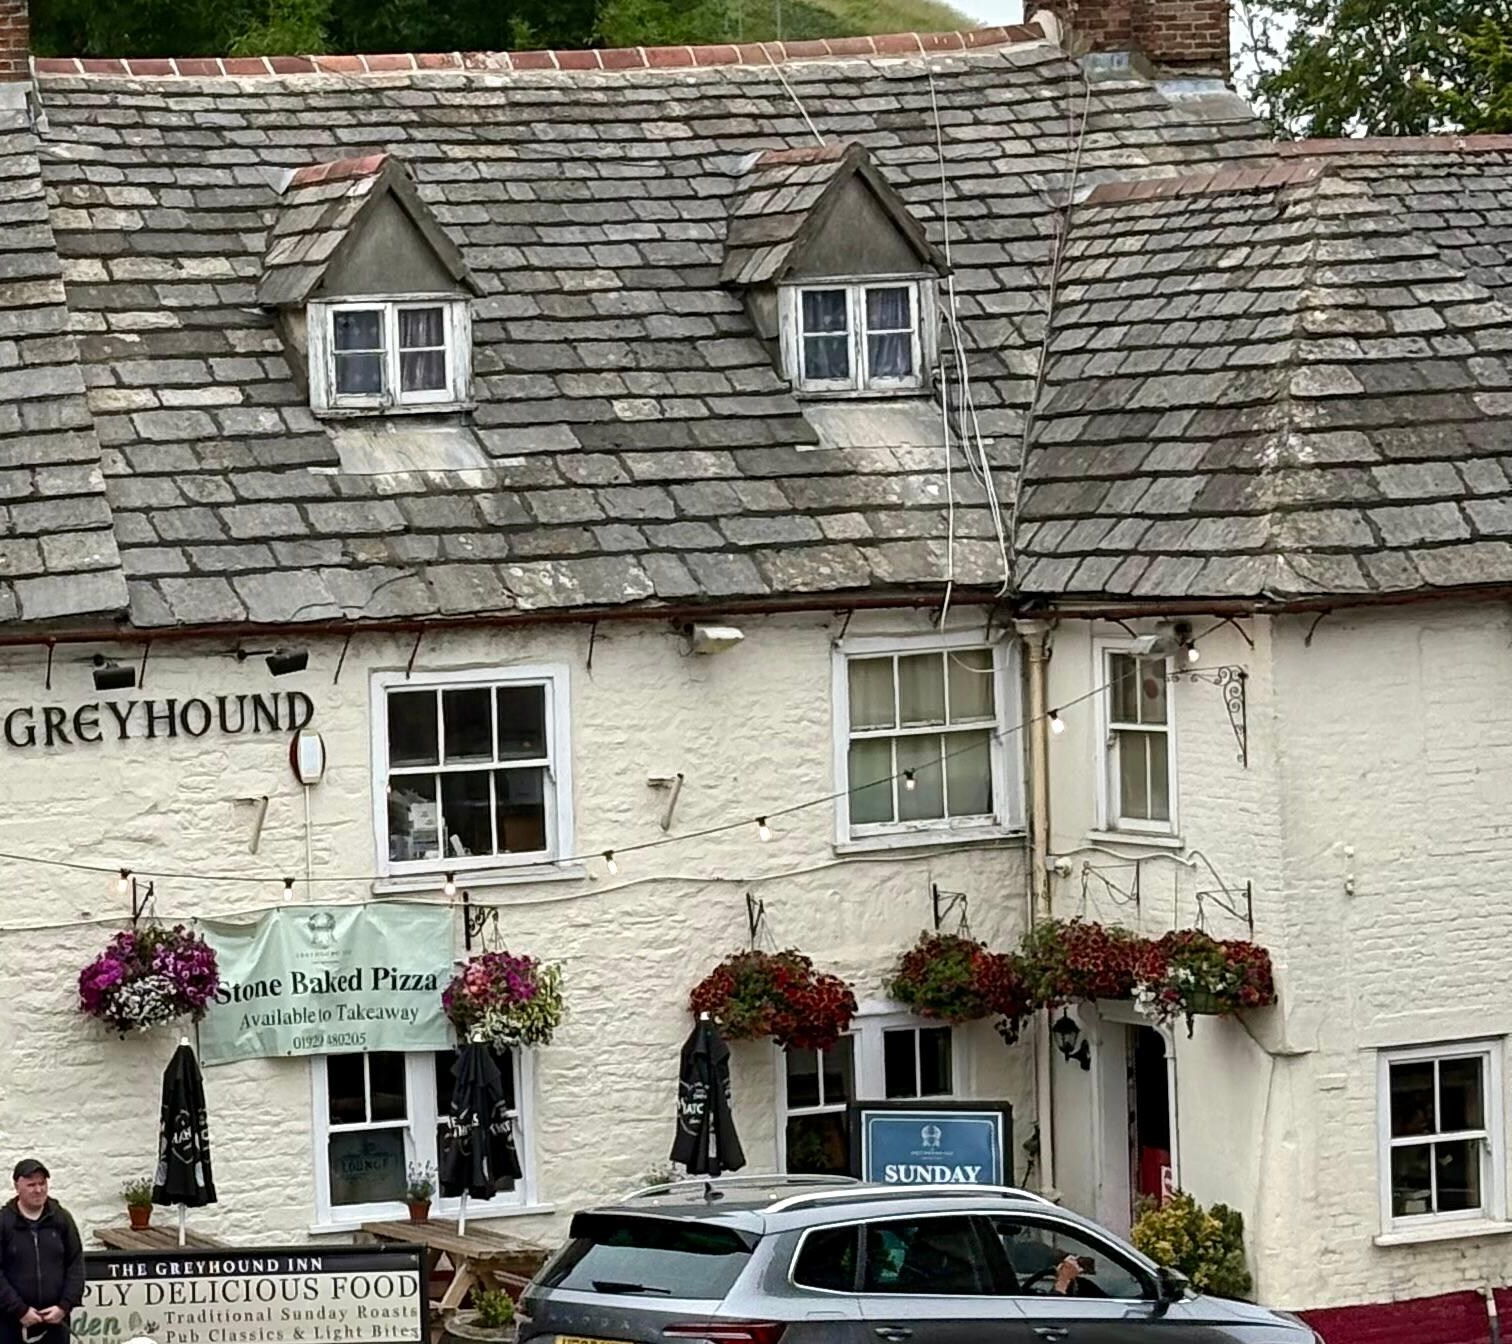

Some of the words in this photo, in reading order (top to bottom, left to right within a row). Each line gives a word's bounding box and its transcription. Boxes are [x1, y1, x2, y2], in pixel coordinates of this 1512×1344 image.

[4, 691, 315, 748] GREYHOUND
[214, 977, 282, 1005] Stone
[291, 968, 362, 995] Baked
[371, 967, 438, 991] Pizza
[239, 1009, 317, 1031] Available
[337, 1004, 419, 1025] Takeaway
[293, 1035, 325, 1049] 01929
[326, 1032, 366, 1048] 480205
[885, 1164, 982, 1183] SUNDAY
[108, 1263, 148, 1278] THE
[155, 1259, 279, 1276] GREYHOUND
[288, 1257, 323, 1272] INN
[144, 1277, 319, 1306] DELICIOUS
[331, 1274, 418, 1300] FOOD
[164, 1308, 272, 1324] Traditional
[281, 1305, 348, 1323] Sunday
[357, 1304, 418, 1319] Roasts
[166, 1329, 200, 1344] Pub
[208, 1327, 284, 1343] Classics
[292, 1328, 305, 1341] &
[313, 1325, 363, 1341] Light
[372, 1323, 420, 1340] Bites
